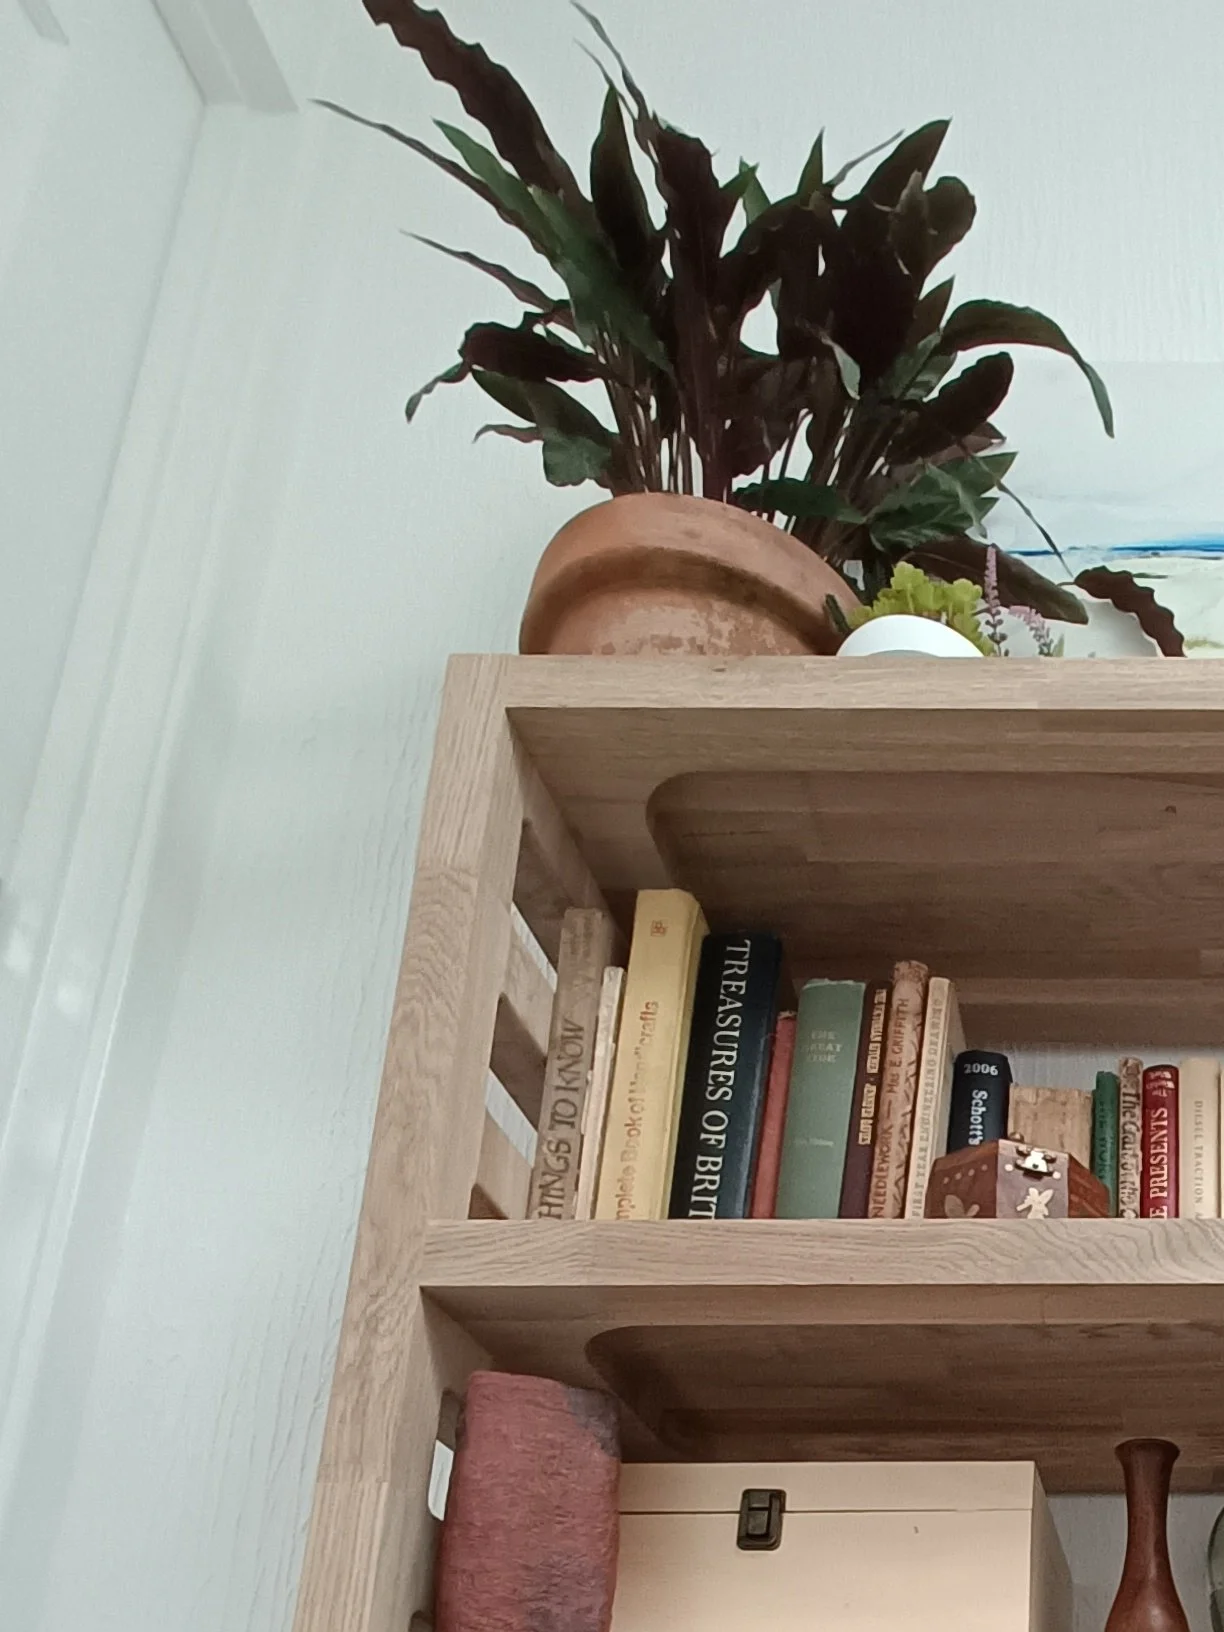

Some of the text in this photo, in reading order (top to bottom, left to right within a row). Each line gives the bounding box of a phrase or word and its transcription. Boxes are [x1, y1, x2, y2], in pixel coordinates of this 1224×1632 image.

[554, 1018, 585, 1093] KNOW
[688, 940, 751, 1219] TREASURES OF BRIT
[963, 1062, 999, 1076] 2006
[547, 1099, 578, 1131] TO
[871, 1124, 893, 1218] NEEDLEWORK
[891, 997, 909, 1055] GRIFFITH
[918, 1059, 937, 1143] ENGINEERING
[967, 1089, 988, 1145] Schott's
[1122, 1091, 1140, 1119] The
[1193, 1100, 1204, 1140] DIESEL
[916, 1147, 928, 1179] YEAR
[1149, 1107, 1168, 1199] PRESENTS
[1193, 1145, 1204, 1204] TRACTION
[912, 1182, 924, 1218] FIRST
